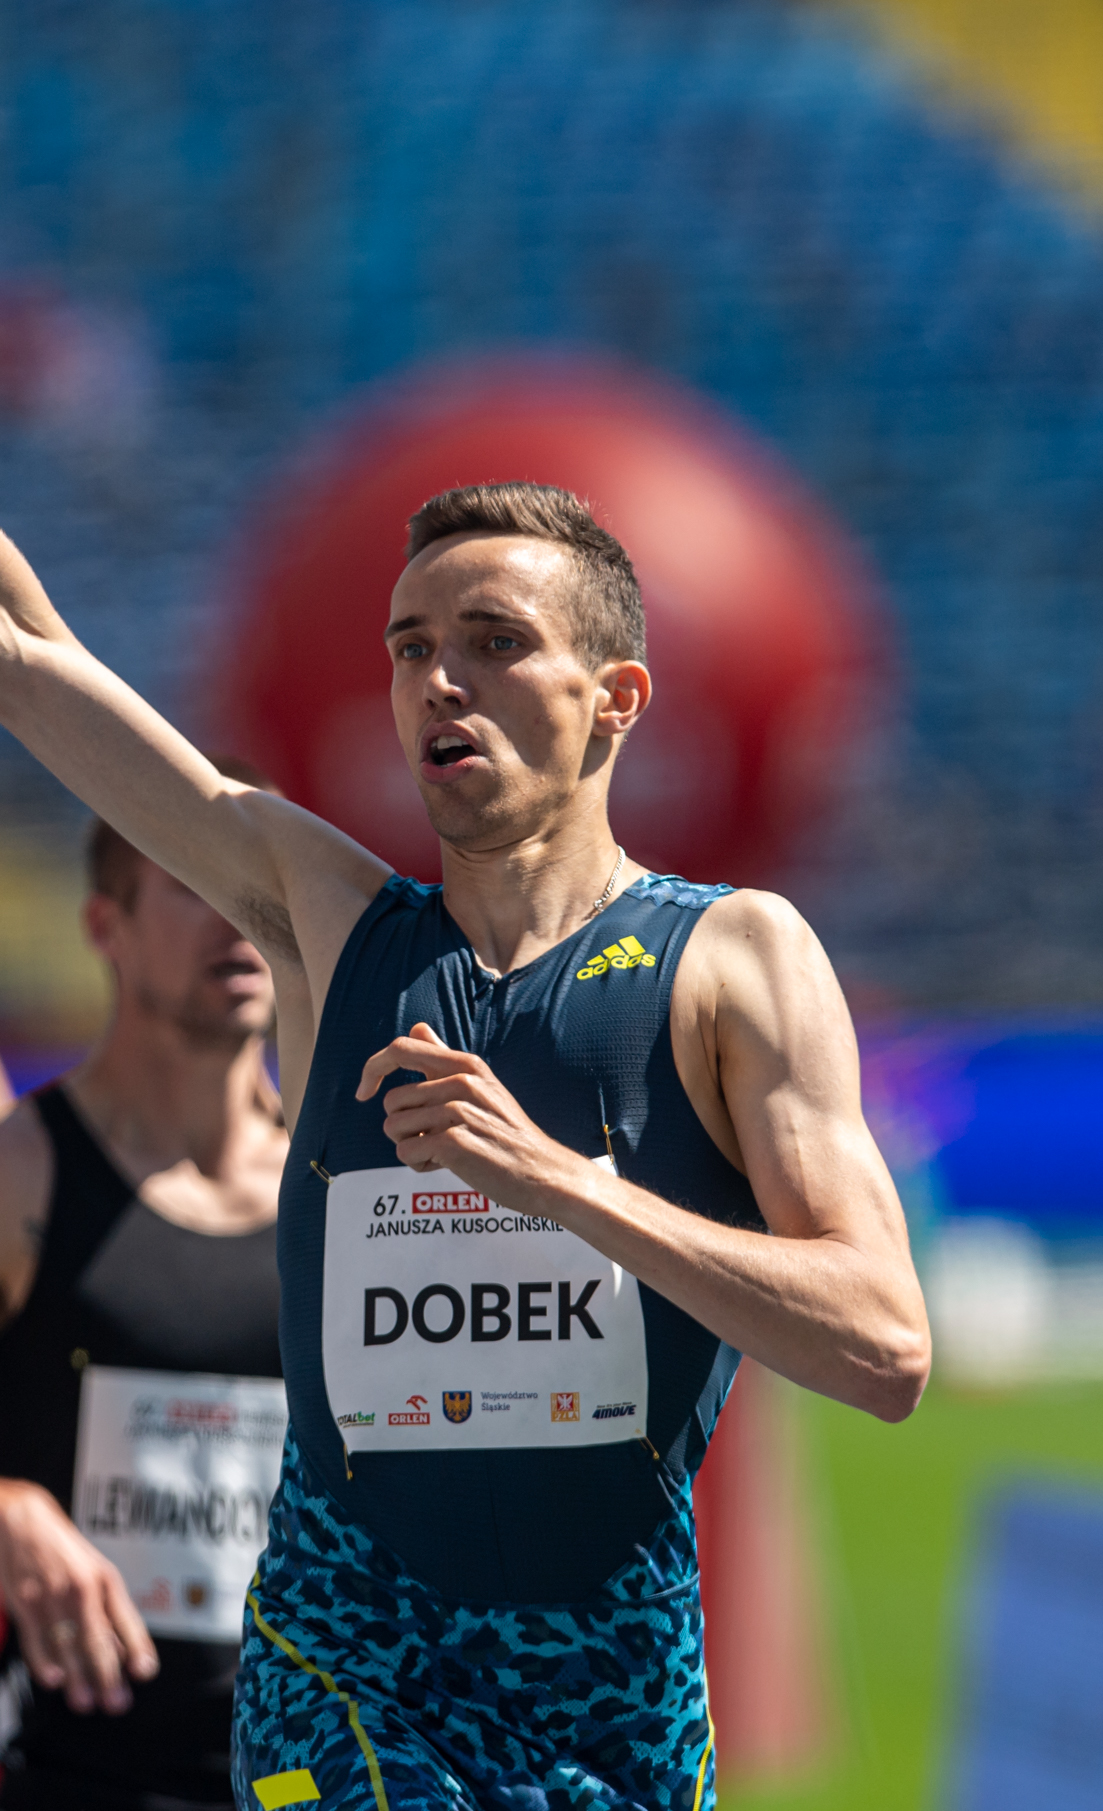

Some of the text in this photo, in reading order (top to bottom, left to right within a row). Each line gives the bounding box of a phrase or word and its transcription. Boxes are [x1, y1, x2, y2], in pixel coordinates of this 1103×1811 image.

[576, 954, 656, 980] addas
[373, 1193, 485, 1217] 67. ORLEN
[366, 1214, 564, 1239] JANUSZA KUSOCIŃSKIE
[364, 1279, 605, 1347] DOBEK
[480, 1391, 538, 1401] Województwo
[481, 1402, 511, 1412] Śląskie
[592, 1404, 637, 1420] 4MOVE
[390, 1413, 429, 1424] ORLEN
